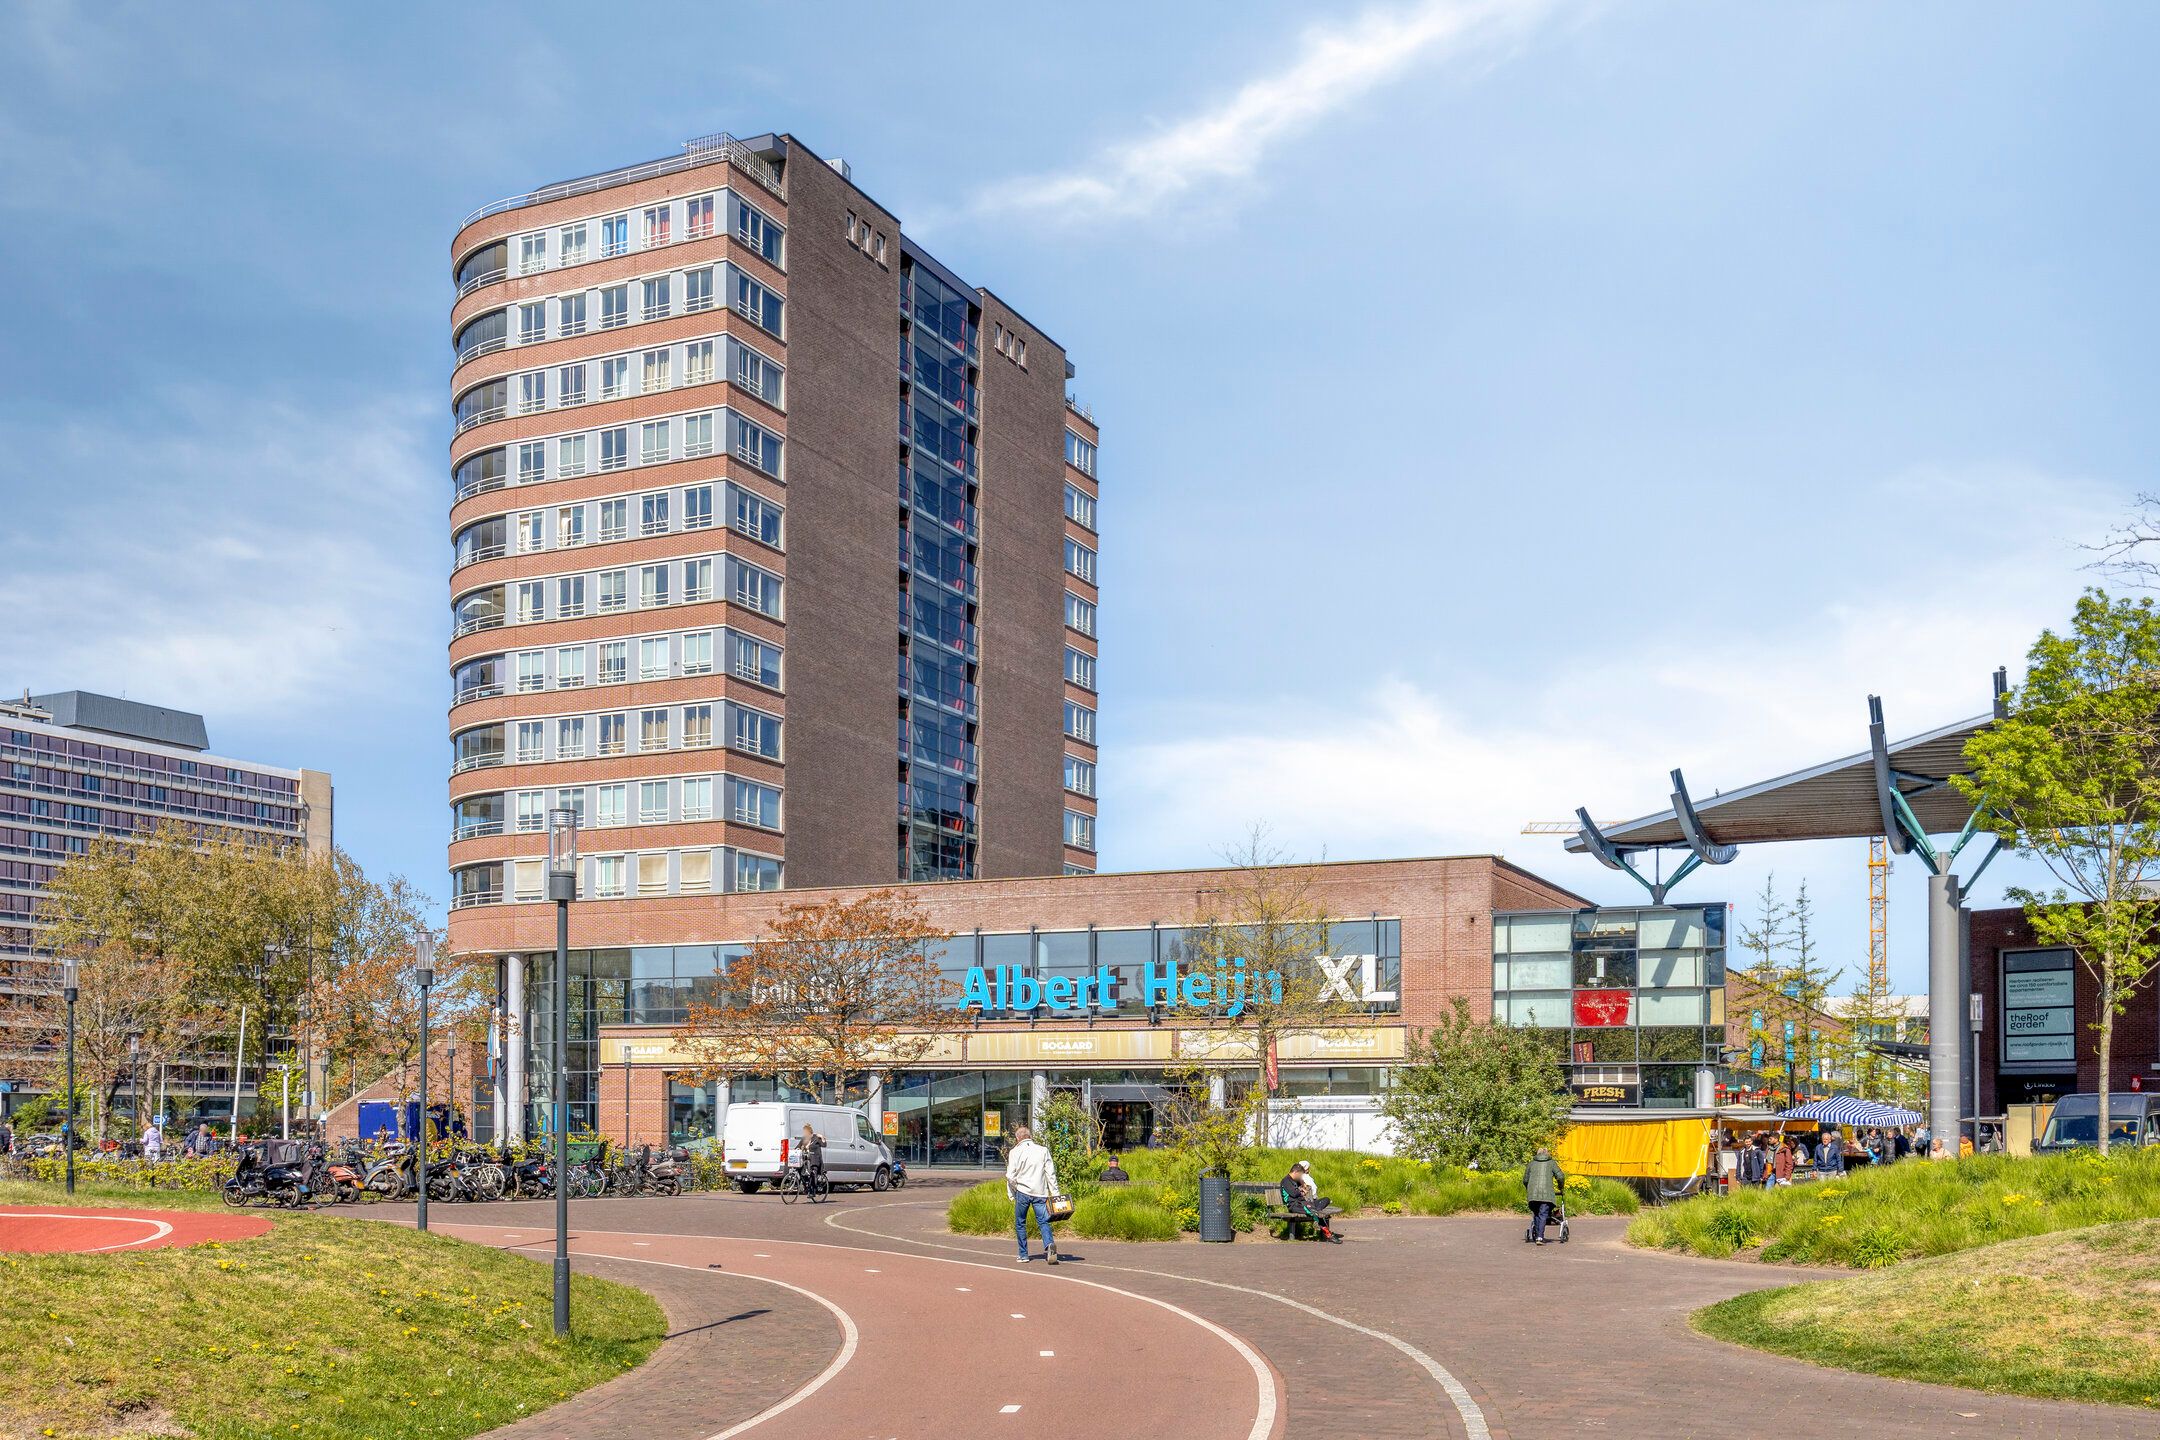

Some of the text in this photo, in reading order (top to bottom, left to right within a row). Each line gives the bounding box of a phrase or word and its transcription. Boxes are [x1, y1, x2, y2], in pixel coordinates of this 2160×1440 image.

[958, 953, 1397, 1017] Albert Heijn XL
[2010, 1012, 2049, 1022] theRoof
[2010, 1020, 2045, 1030] garden
[1042, 1041, 1093, 1050] BOGAARD
[1583, 1087, 1625, 1099] FRESH
